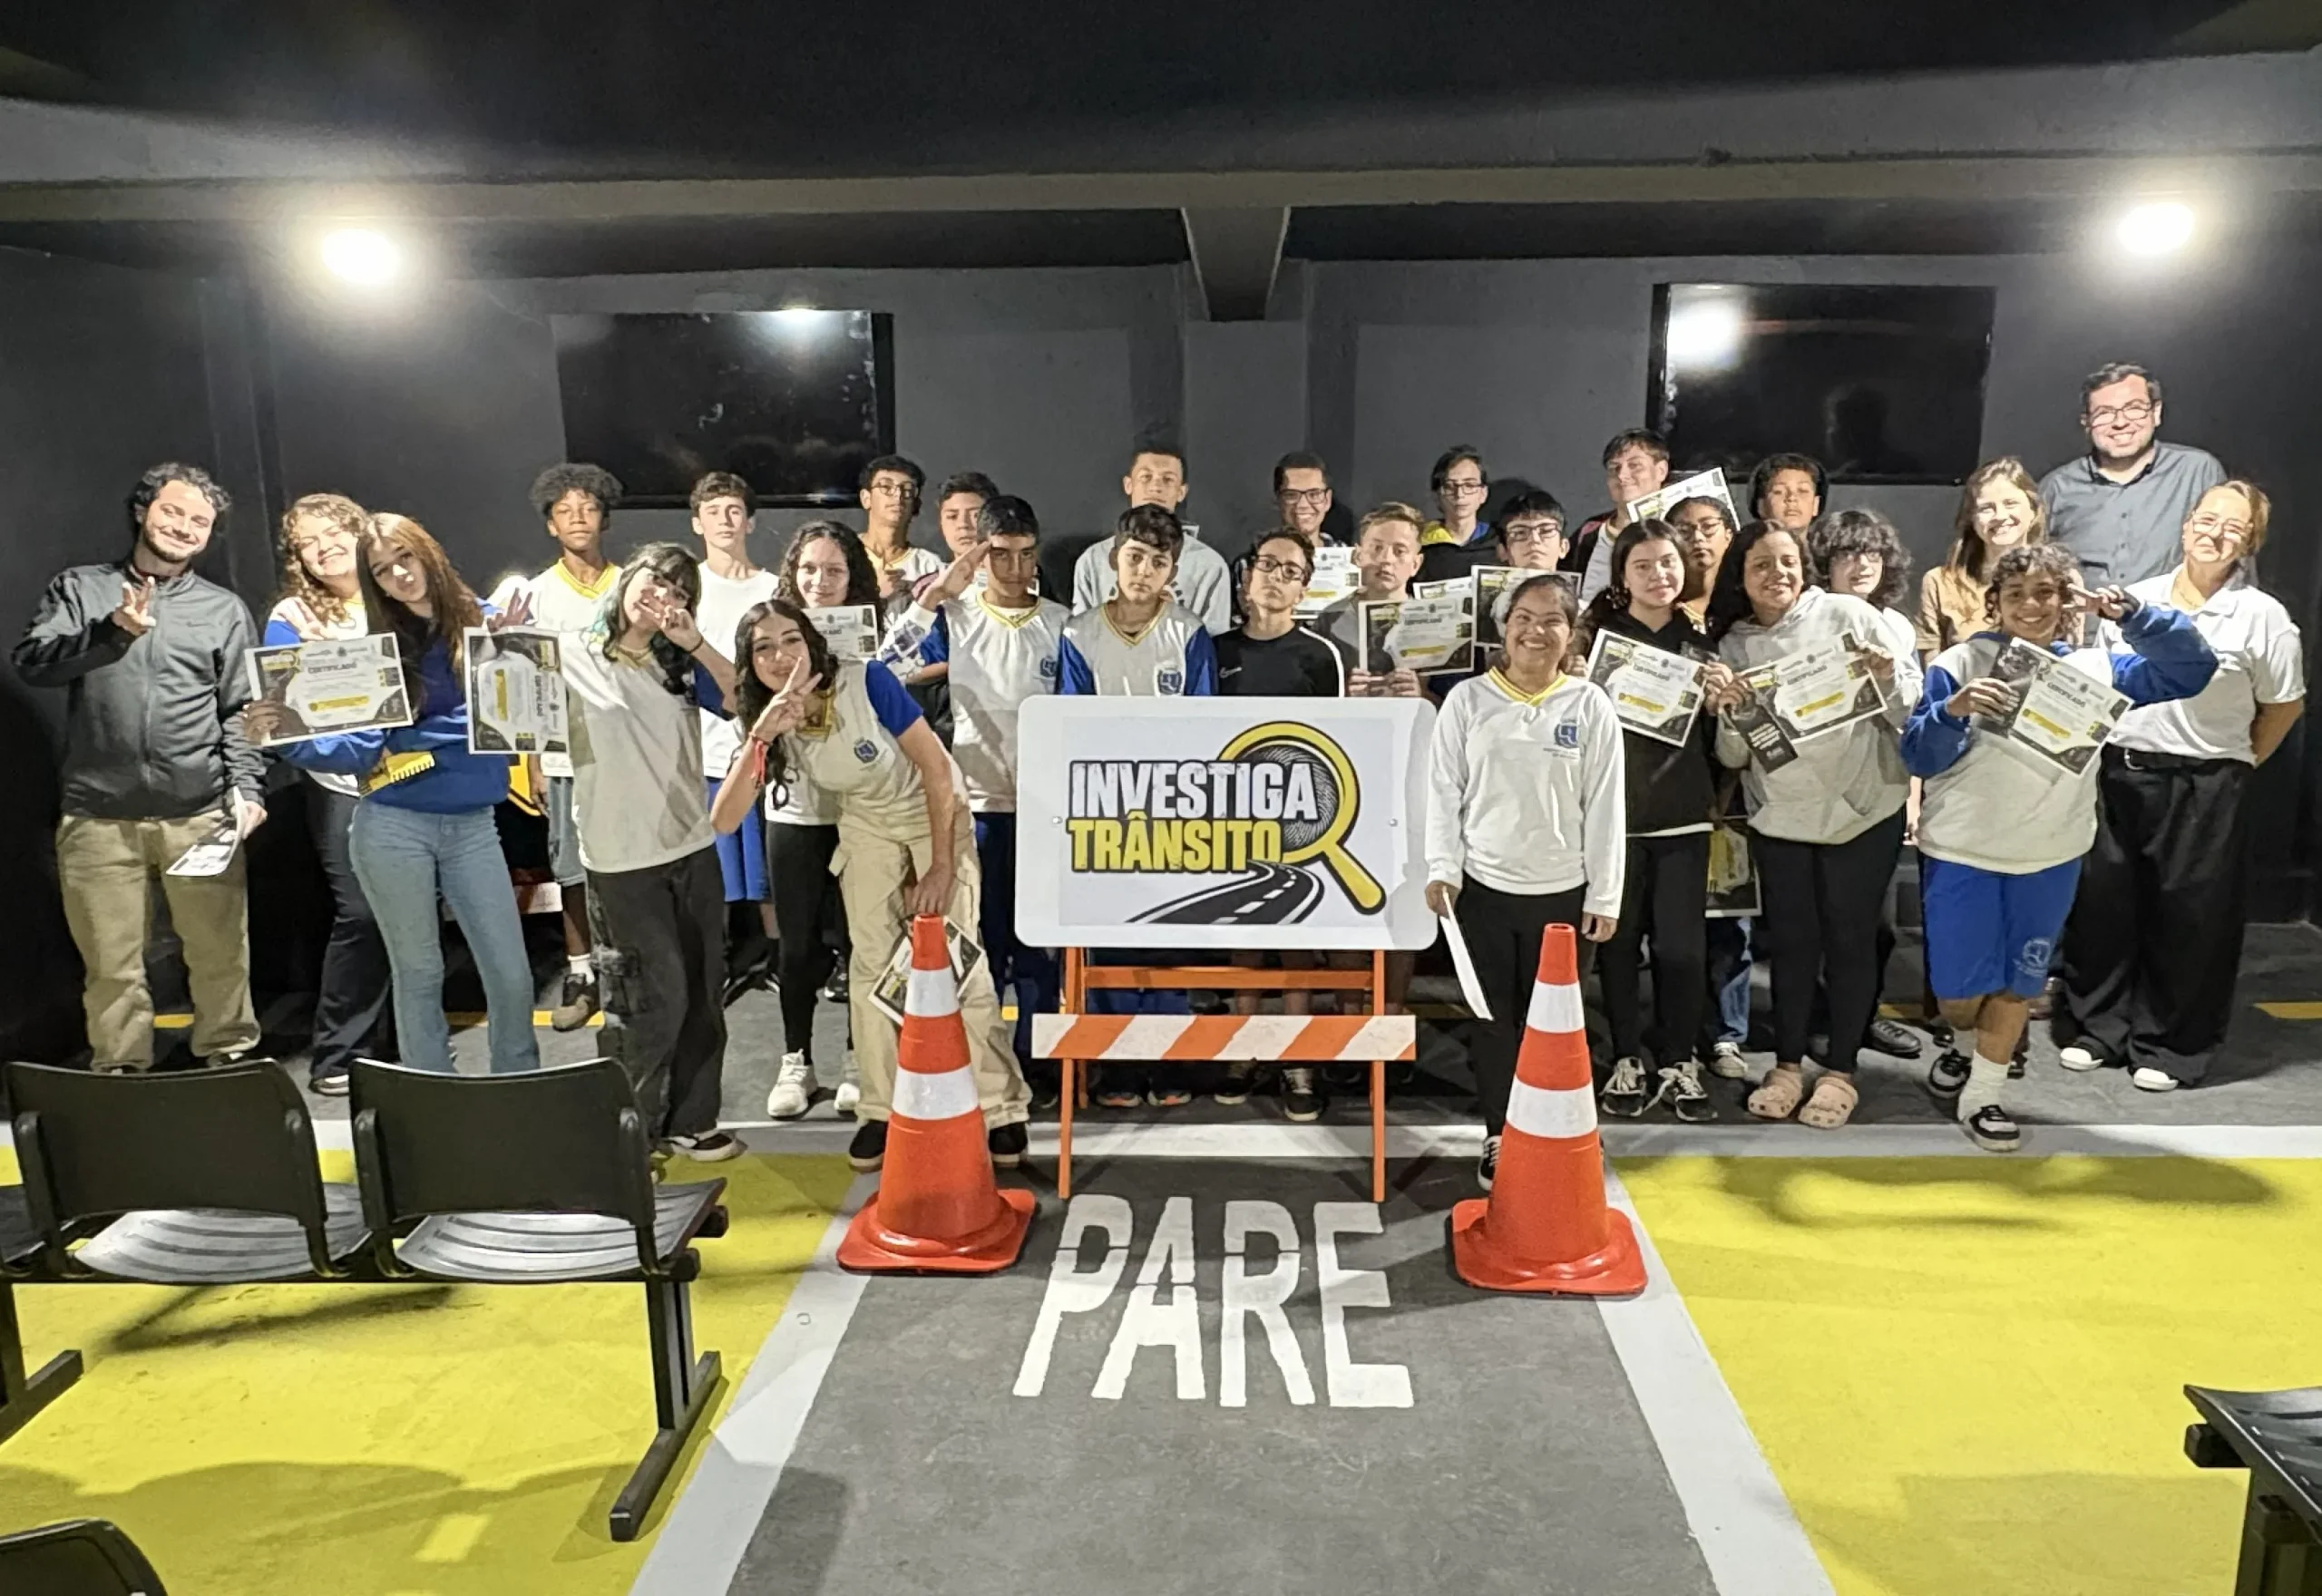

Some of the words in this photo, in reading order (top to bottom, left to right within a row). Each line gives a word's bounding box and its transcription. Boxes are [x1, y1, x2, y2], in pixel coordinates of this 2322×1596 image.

[1069, 761, 1318, 820] INVESTIGA
[1067, 810, 1282, 874] TRÂNSITO
[1012, 1194, 1414, 1406] PARE
